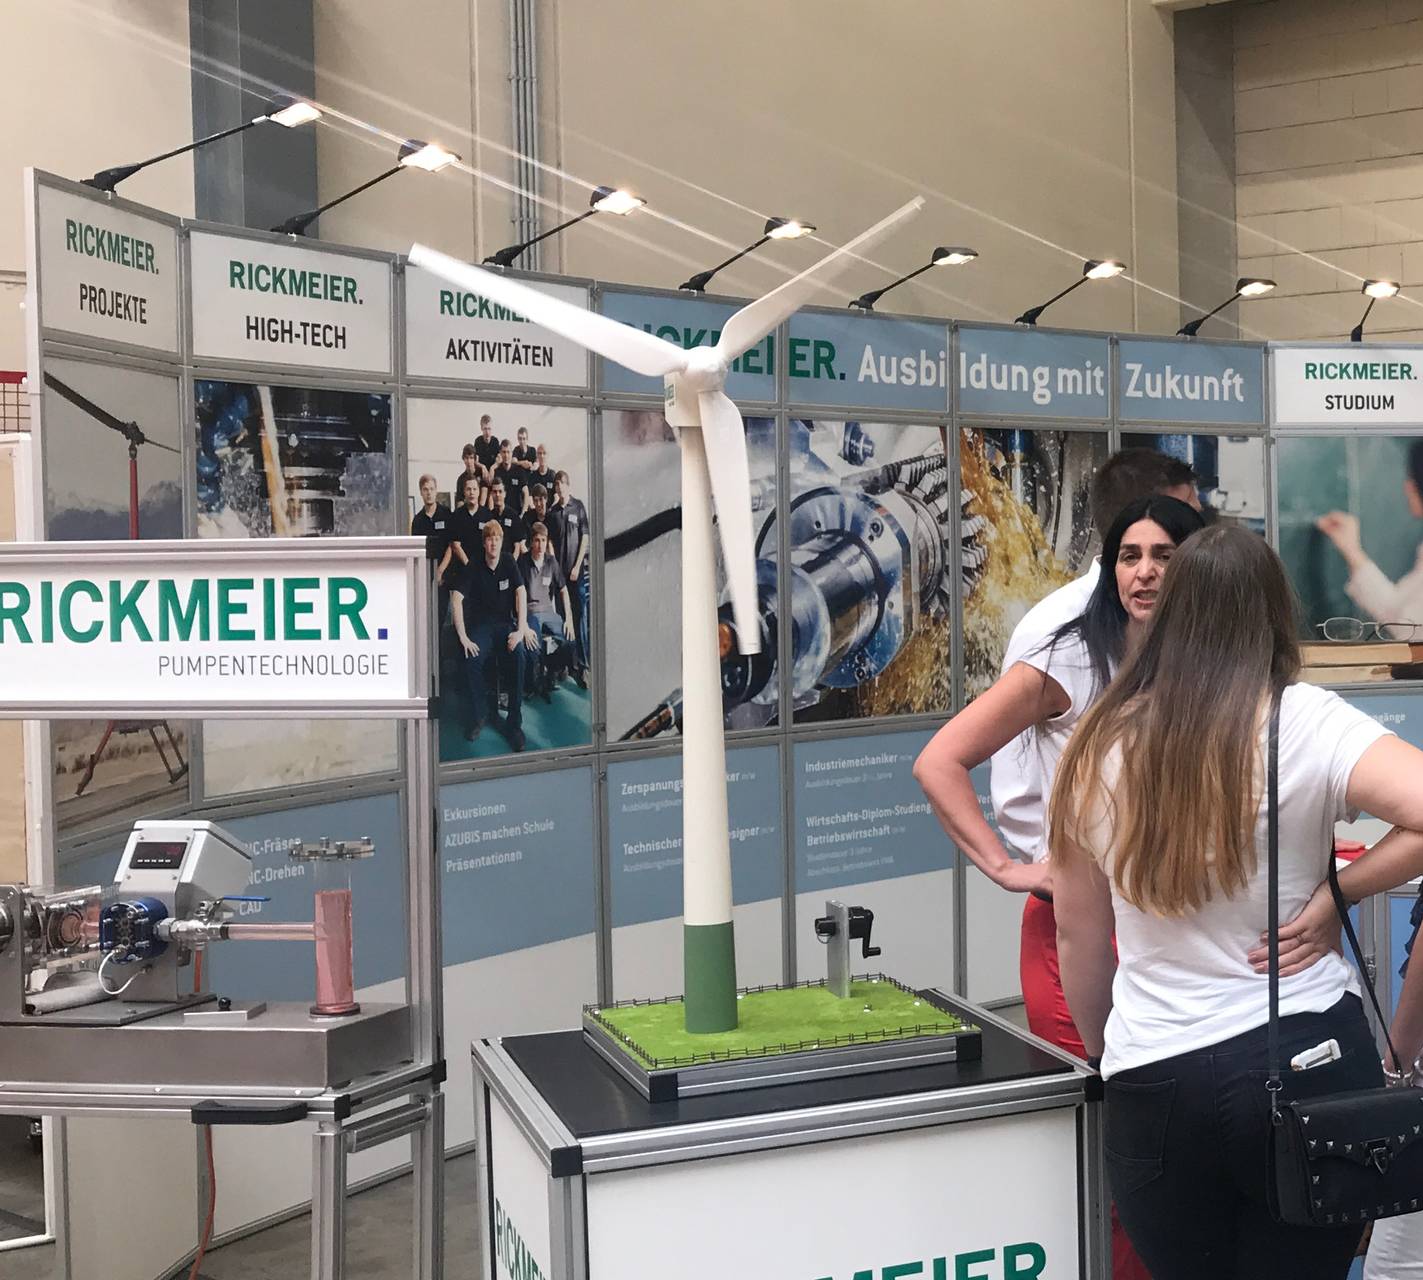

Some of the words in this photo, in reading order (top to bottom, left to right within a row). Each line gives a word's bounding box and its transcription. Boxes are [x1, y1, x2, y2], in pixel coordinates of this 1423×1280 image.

[66, 218, 159, 275] RICKMEIER.
[229, 260, 363, 305] RICKMEIER.
[80, 282, 147, 325] PROJEKTE
[440, 290, 533, 323] RICKM
[246, 315, 346, 350] HIGH-TECH
[446, 338, 554, 368] AKTIVITÄTEN
[857, 344, 1052, 406] Ausbildung
[1056, 361, 1104, 397] mit
[1126, 363, 1245, 403] Zukunft
[1305, 362, 1418, 380] RICKMEIER.
[1325, 394, 1394, 410] STUDIUM
[0, 577, 389, 644] RICKMEIER.
[158, 653, 390, 677] PUMPENTECHNOLOGIE
[805, 753, 898, 772] Industriemechaniker
[444, 803, 506, 822] Exkursionen
[806, 802, 933, 828] Wirtschafts-Diplom-Studieng
[444, 830, 480, 848] AZUBIS
[482, 824, 521, 841] machen
[523, 819, 555, 835] Schule
[806, 825, 891, 847] Betriebswirtschaft
[247, 864, 305, 885] NC-Drehen
[446, 850, 523, 873] Präsentationen
